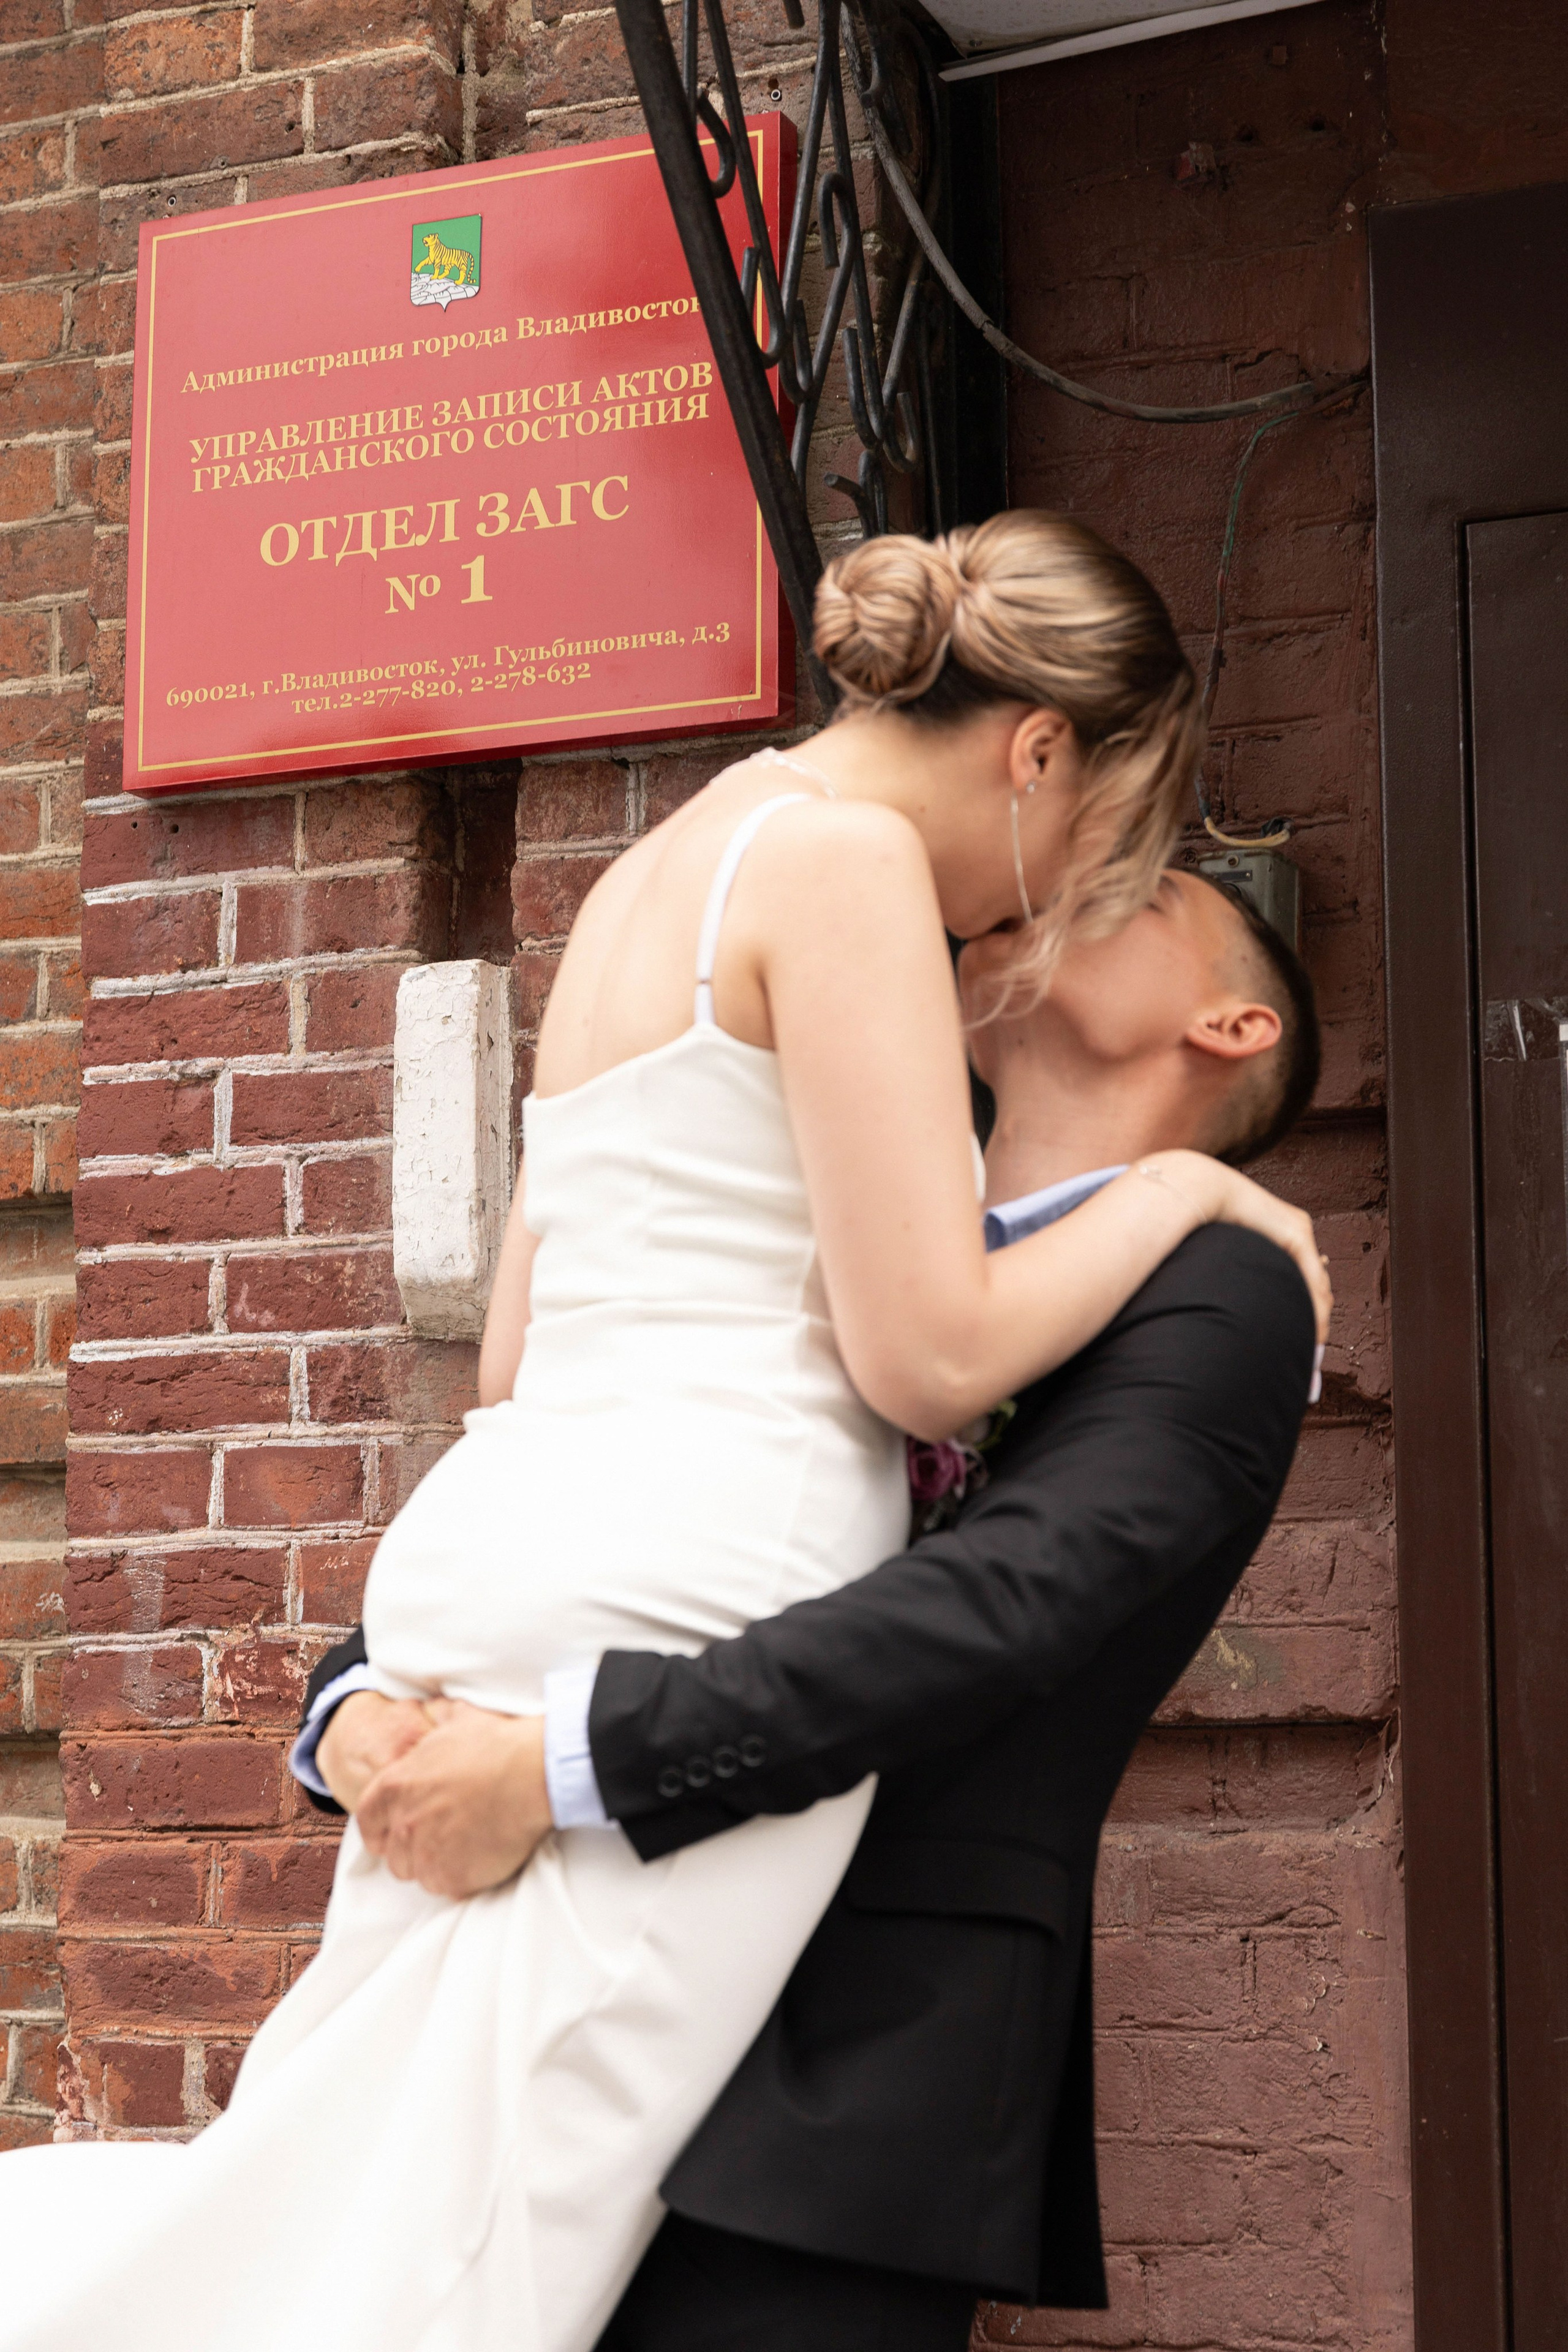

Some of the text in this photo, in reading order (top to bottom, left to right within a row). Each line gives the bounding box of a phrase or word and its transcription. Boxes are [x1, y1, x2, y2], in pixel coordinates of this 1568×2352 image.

[181, 342, 404, 394] Администрация
[412, 325, 508, 358] города
[189, 361, 714, 464] УПРАВЛЕНИЕ ЗАПИСИ АКТОВ
[192, 393, 710, 493] ГРАЖДАНСКОГО СОСТОЯНИЯ
[260, 474, 630, 567] ОТДЕЛ ЗАГС
[384, 554, 494, 614] № 1
[166, 622, 731, 709] 690021, г.Владивосток, ул. Гульбиновича, д.3
[291, 662, 592, 714] тел.2-277-820, 2-278-632
